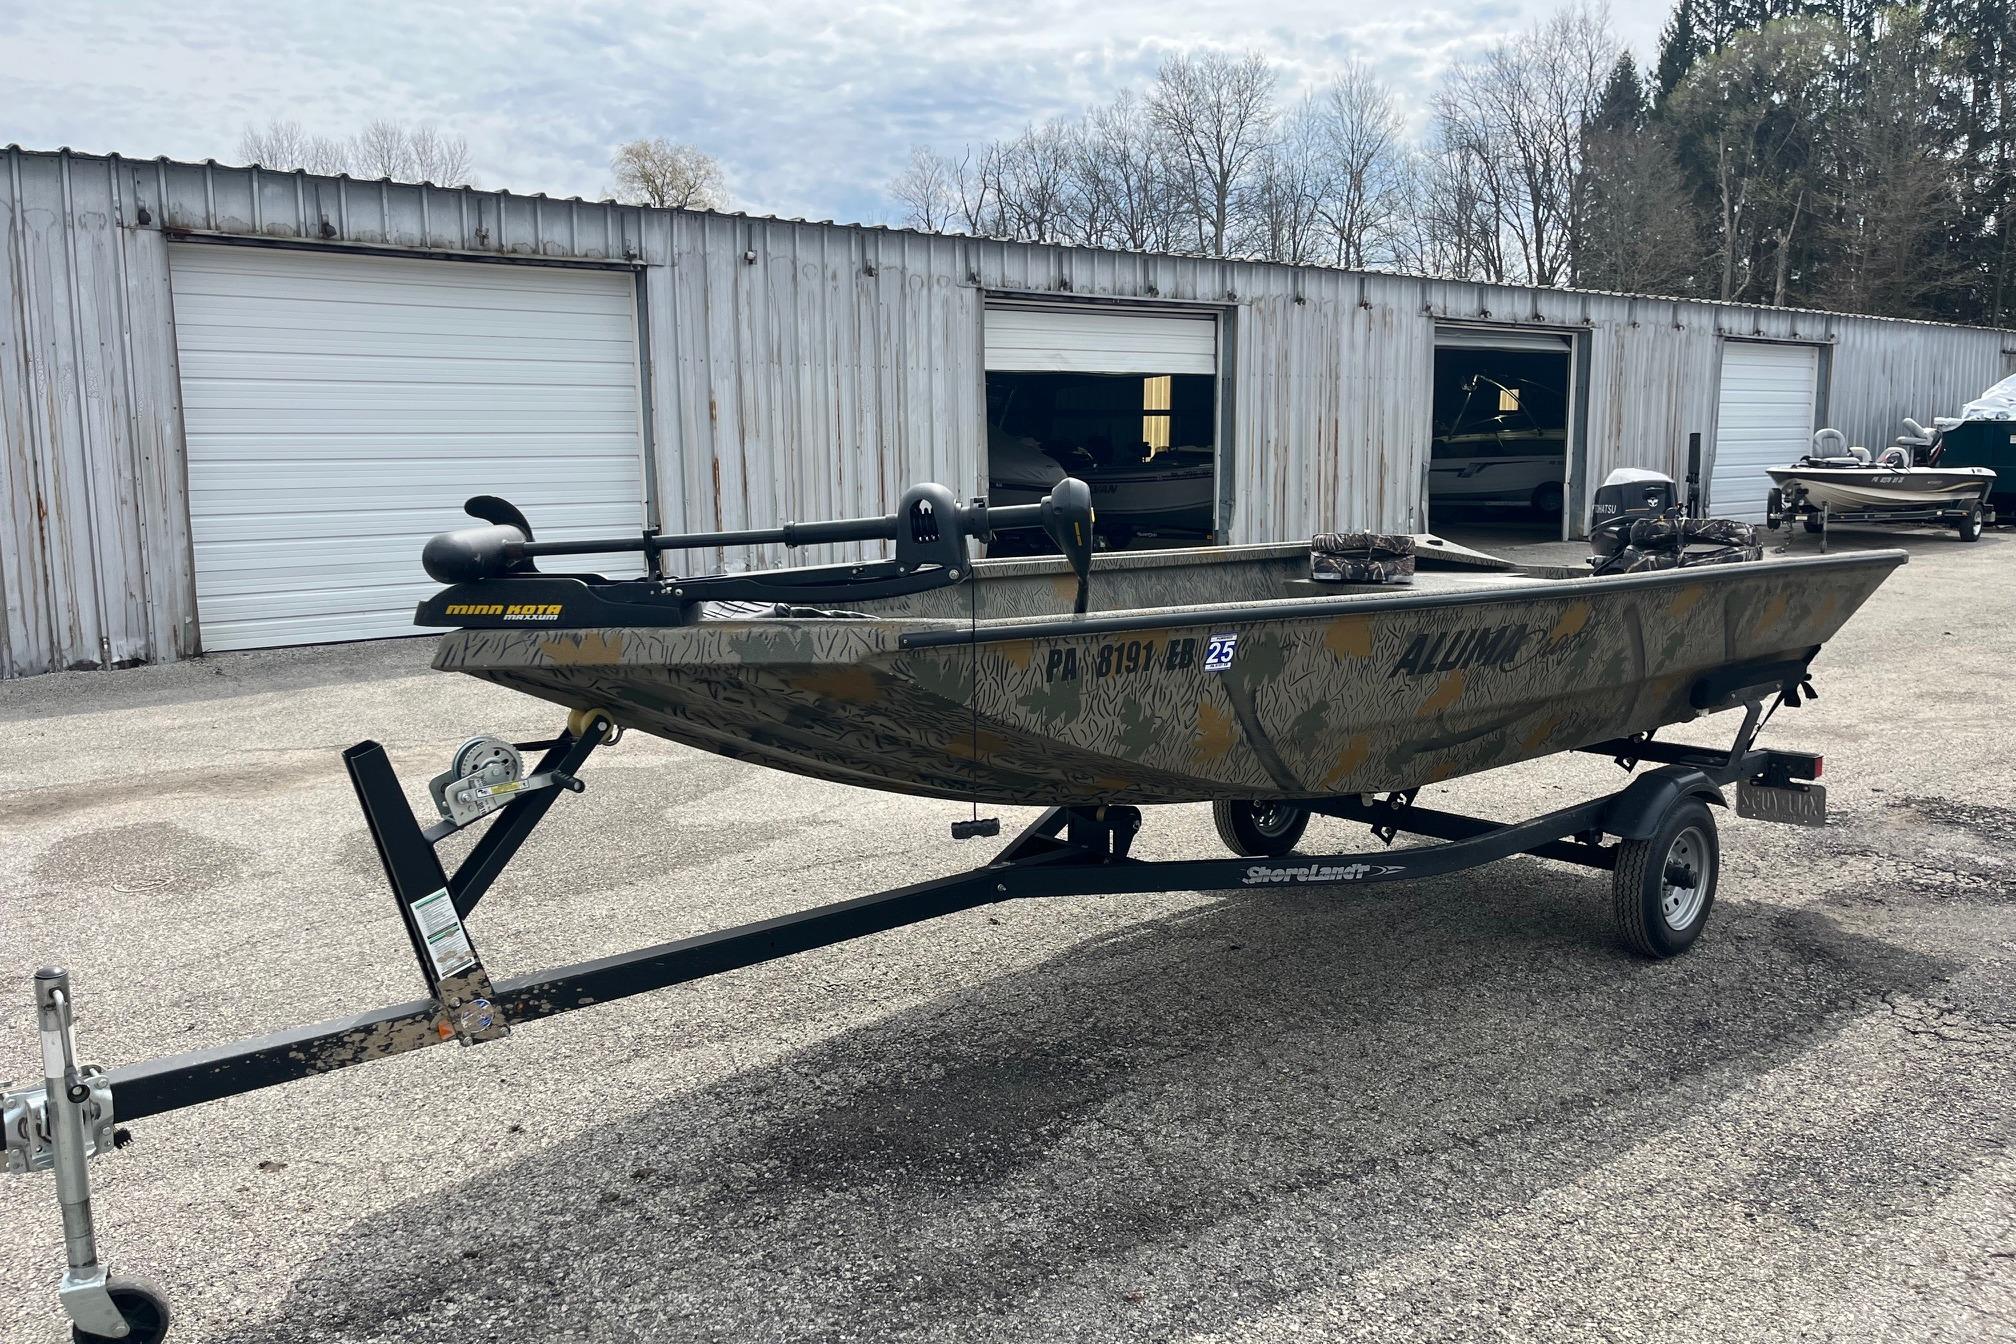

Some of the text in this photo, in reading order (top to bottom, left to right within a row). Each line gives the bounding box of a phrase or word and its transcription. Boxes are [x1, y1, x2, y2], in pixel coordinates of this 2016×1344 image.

[445, 604, 563, 615] MINN KOTA
[1047, 647, 1077, 683] PA
[1099, 640, 1155, 678] 8191
[1206, 640, 1235, 664] 25
